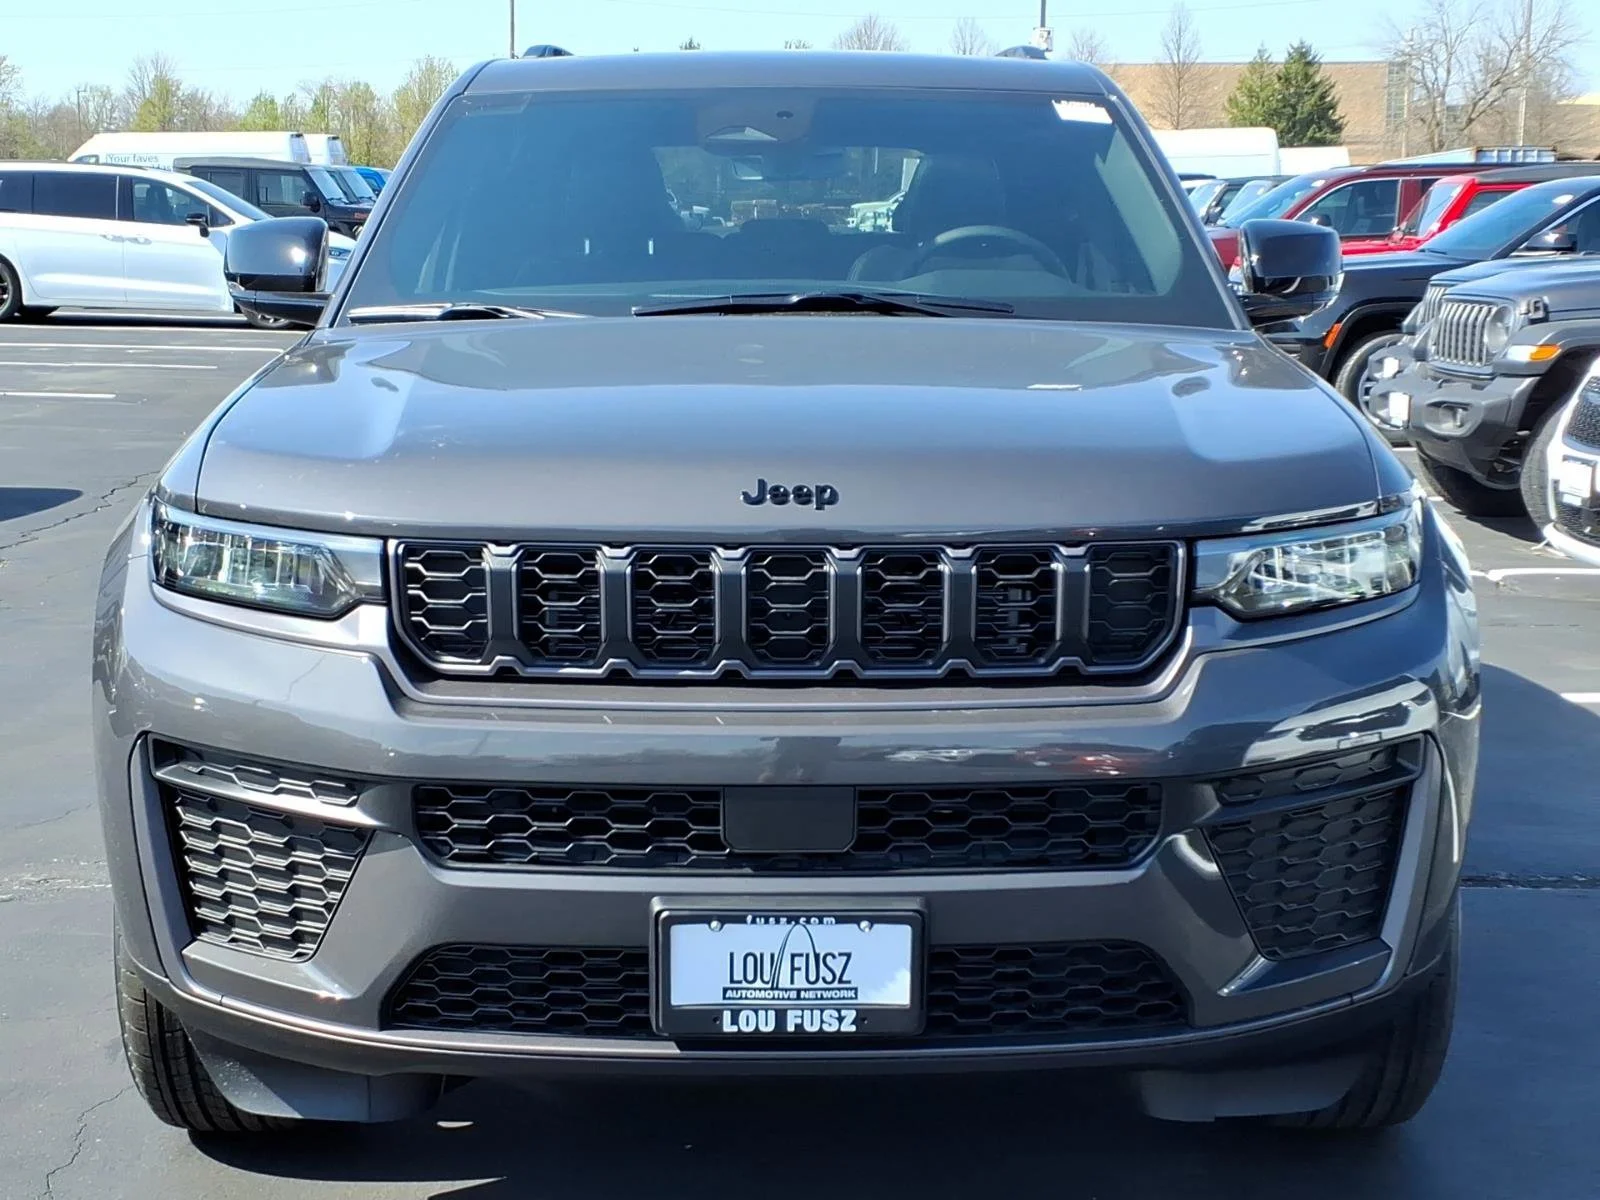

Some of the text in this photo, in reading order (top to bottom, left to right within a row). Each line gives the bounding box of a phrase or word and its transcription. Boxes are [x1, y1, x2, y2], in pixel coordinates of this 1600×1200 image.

[109, 154, 130, 164] Your
[741, 478, 840, 511] Jeep
[746, 914, 836, 925] fusz.com
[729, 952, 853, 985] LOU FUSZ
[725, 989, 856, 999] AUTOMOTIVE NETWORK
[722, 1010, 857, 1033] LOU FUSZ
